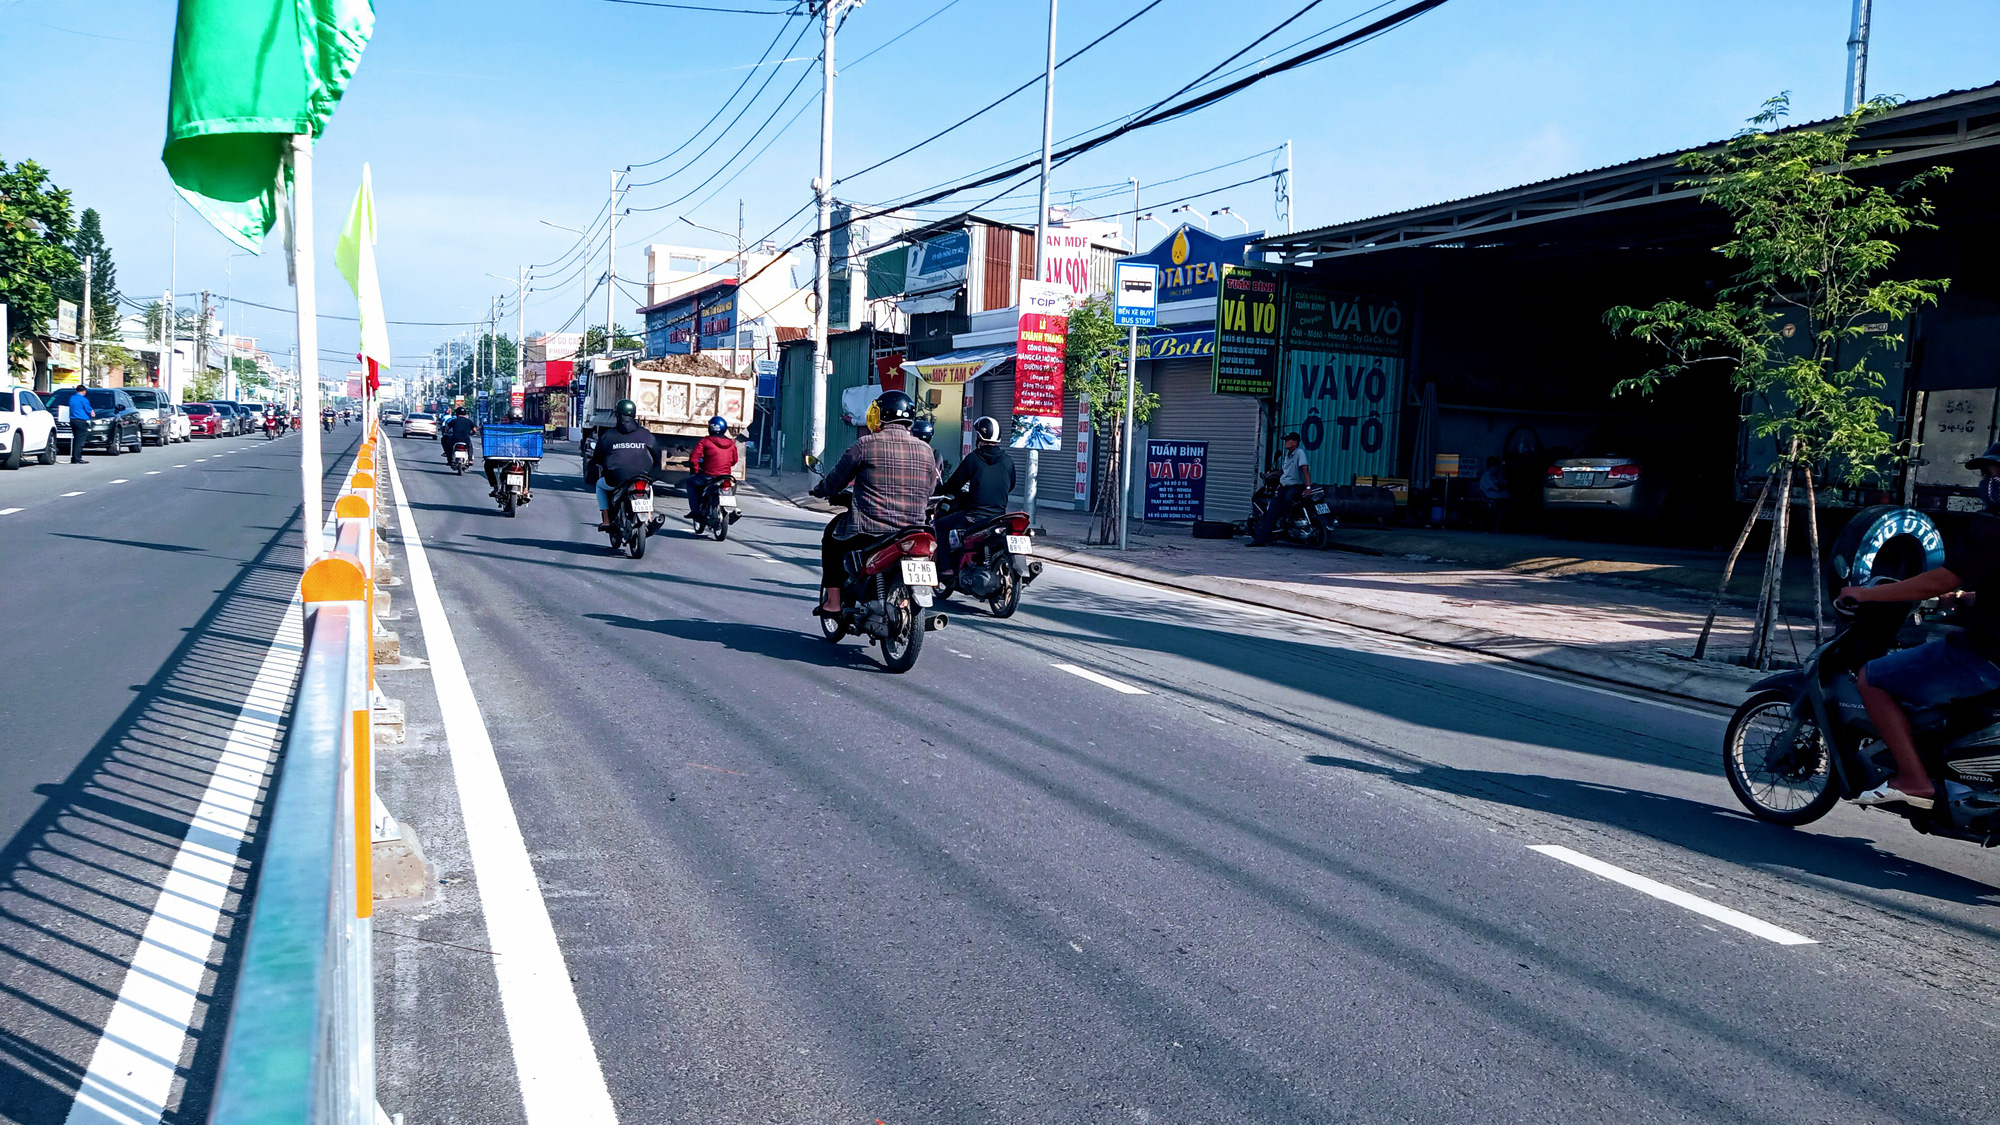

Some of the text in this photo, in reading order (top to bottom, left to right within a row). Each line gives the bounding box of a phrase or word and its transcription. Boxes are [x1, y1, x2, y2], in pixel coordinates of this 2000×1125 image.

[1065, 236, 1088, 247] MDF
[1030, 297, 1056, 307] TCIP
[1118, 306, 1130, 316] BẾN
[1224, 293, 1275, 333] VÁ VỎ
[1330, 296, 1401, 335] VÁ VỎ
[1121, 316, 1134, 324] BUS
[1327, 332, 1348, 341] Honda
[738, 354, 751, 367] OFA
[932, 367, 948, 383] MDF
[949, 366, 967, 383] TAM
[1300, 355, 1386, 403] VÁ VỎ
[1301, 407, 1383, 453] Ô TÔ
[612, 442, 646, 450] MISSOUT
[1151, 443, 1204, 457] TUẤN BÌNH
[1149, 458, 1203, 480] VÁ VỎ
[907, 562, 932, 573] 47-N6
[909, 573, 932, 583] 1341
[1959, 774, 1994, 783] HONDA
